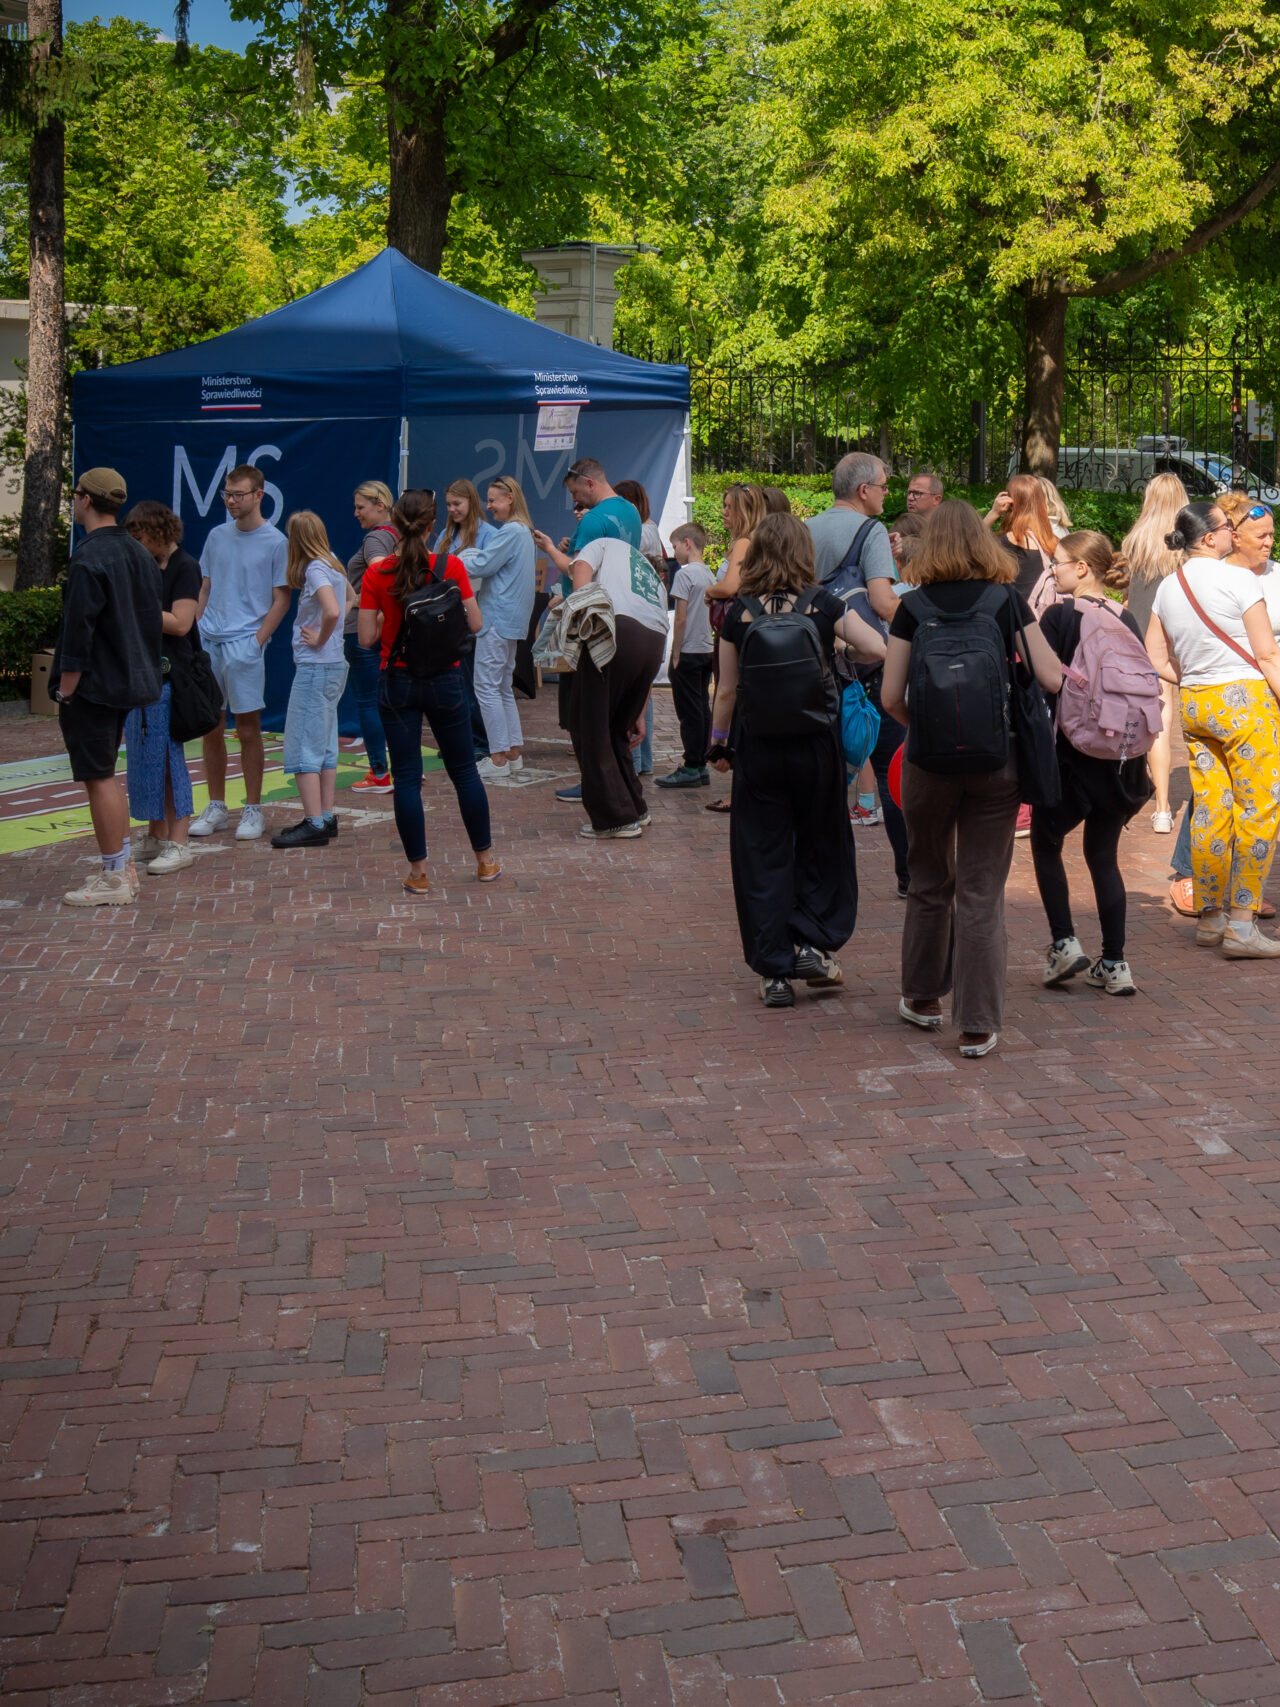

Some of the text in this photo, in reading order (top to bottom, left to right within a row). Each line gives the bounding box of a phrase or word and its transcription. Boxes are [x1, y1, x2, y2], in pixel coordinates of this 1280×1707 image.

[201, 376, 251, 386] Ministerstwo
[534, 373, 578, 382] Ministerstwo
[201, 388, 263, 401] Sprawiedliwości
[535, 385, 588, 396] Sprawiedliwości
